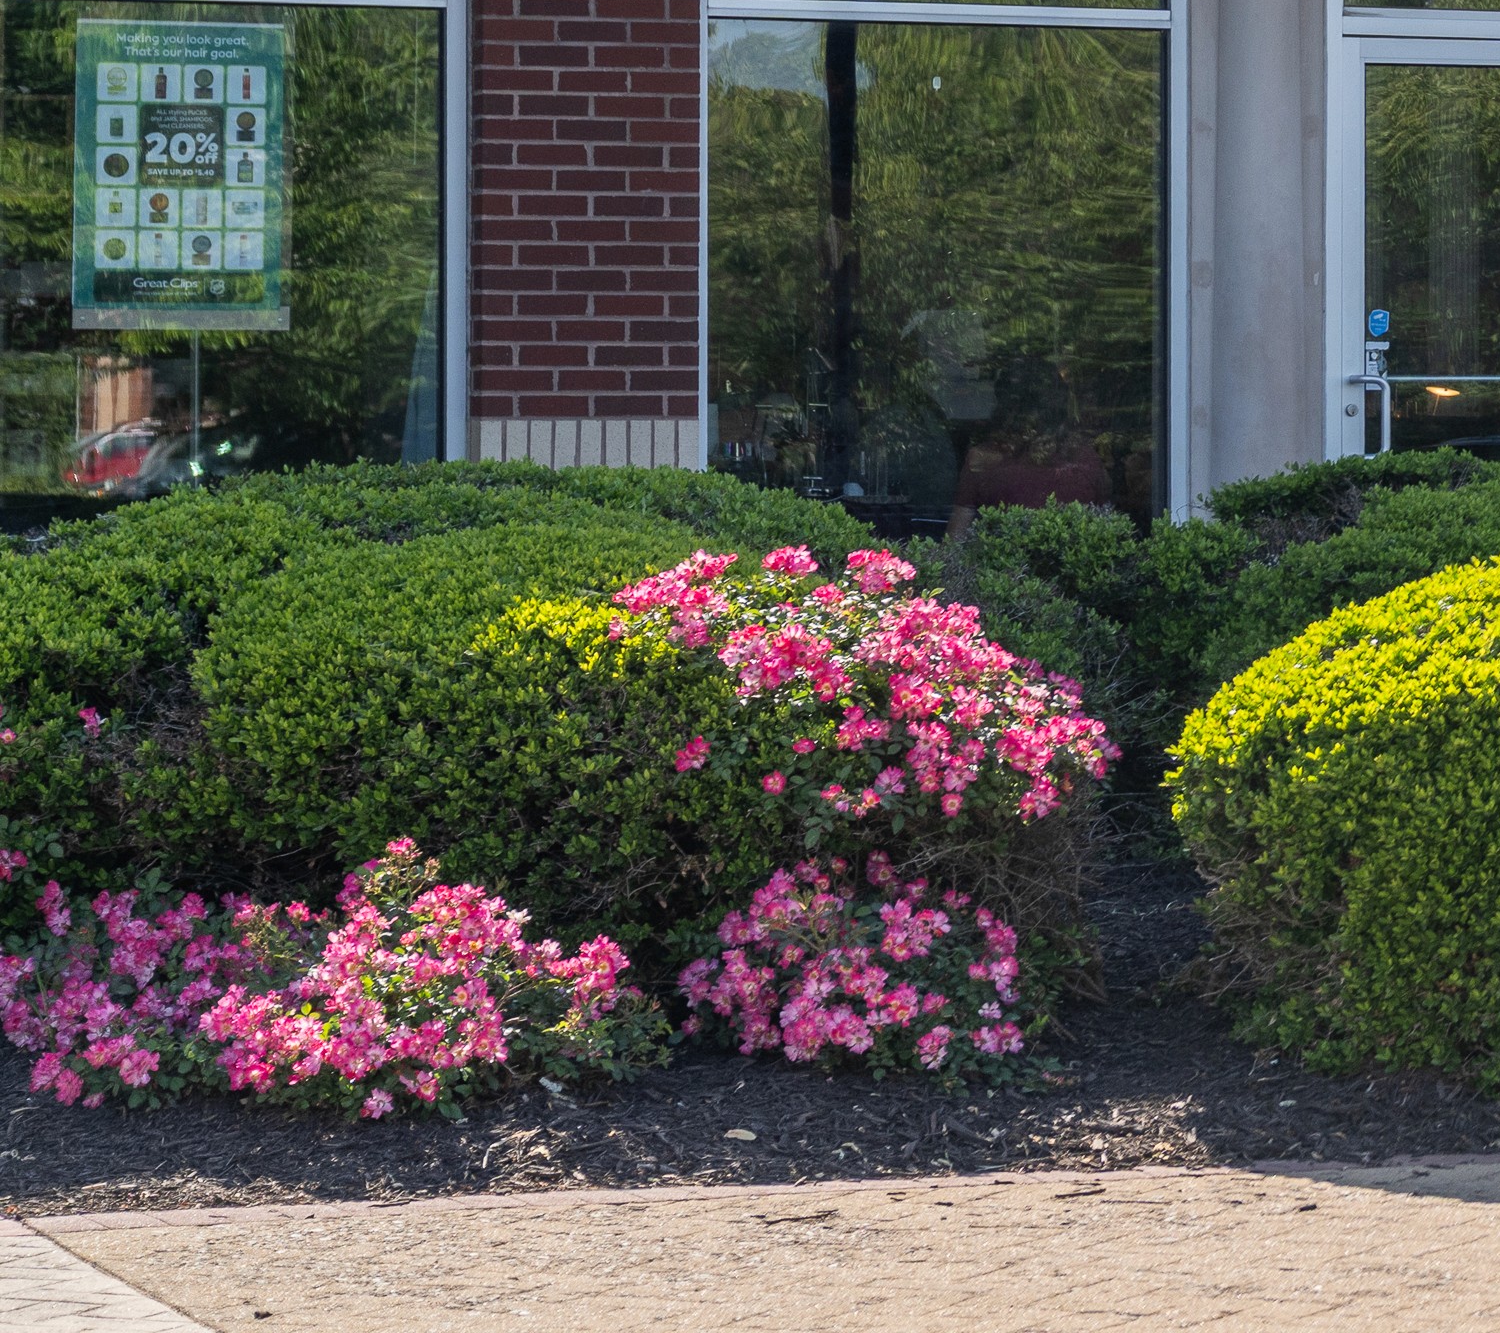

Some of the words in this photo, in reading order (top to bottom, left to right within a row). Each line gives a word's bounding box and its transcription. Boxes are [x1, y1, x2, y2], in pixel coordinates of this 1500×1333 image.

[115, 32, 160, 44] Making
[162, 35, 184, 46] you
[186, 33, 211, 45] look
[214, 37, 250, 47] great.
[124, 46, 160, 58] That's
[162, 48, 182, 58] our
[184, 47, 208, 59] hair
[210, 47, 240, 60] goal.
[144, 132, 219, 164] 20%
[195, 152, 218, 164] off
[147, 168, 170, 176] SAVE
[133, 277, 168, 288] Great
[169, 278, 198, 289] Clips
